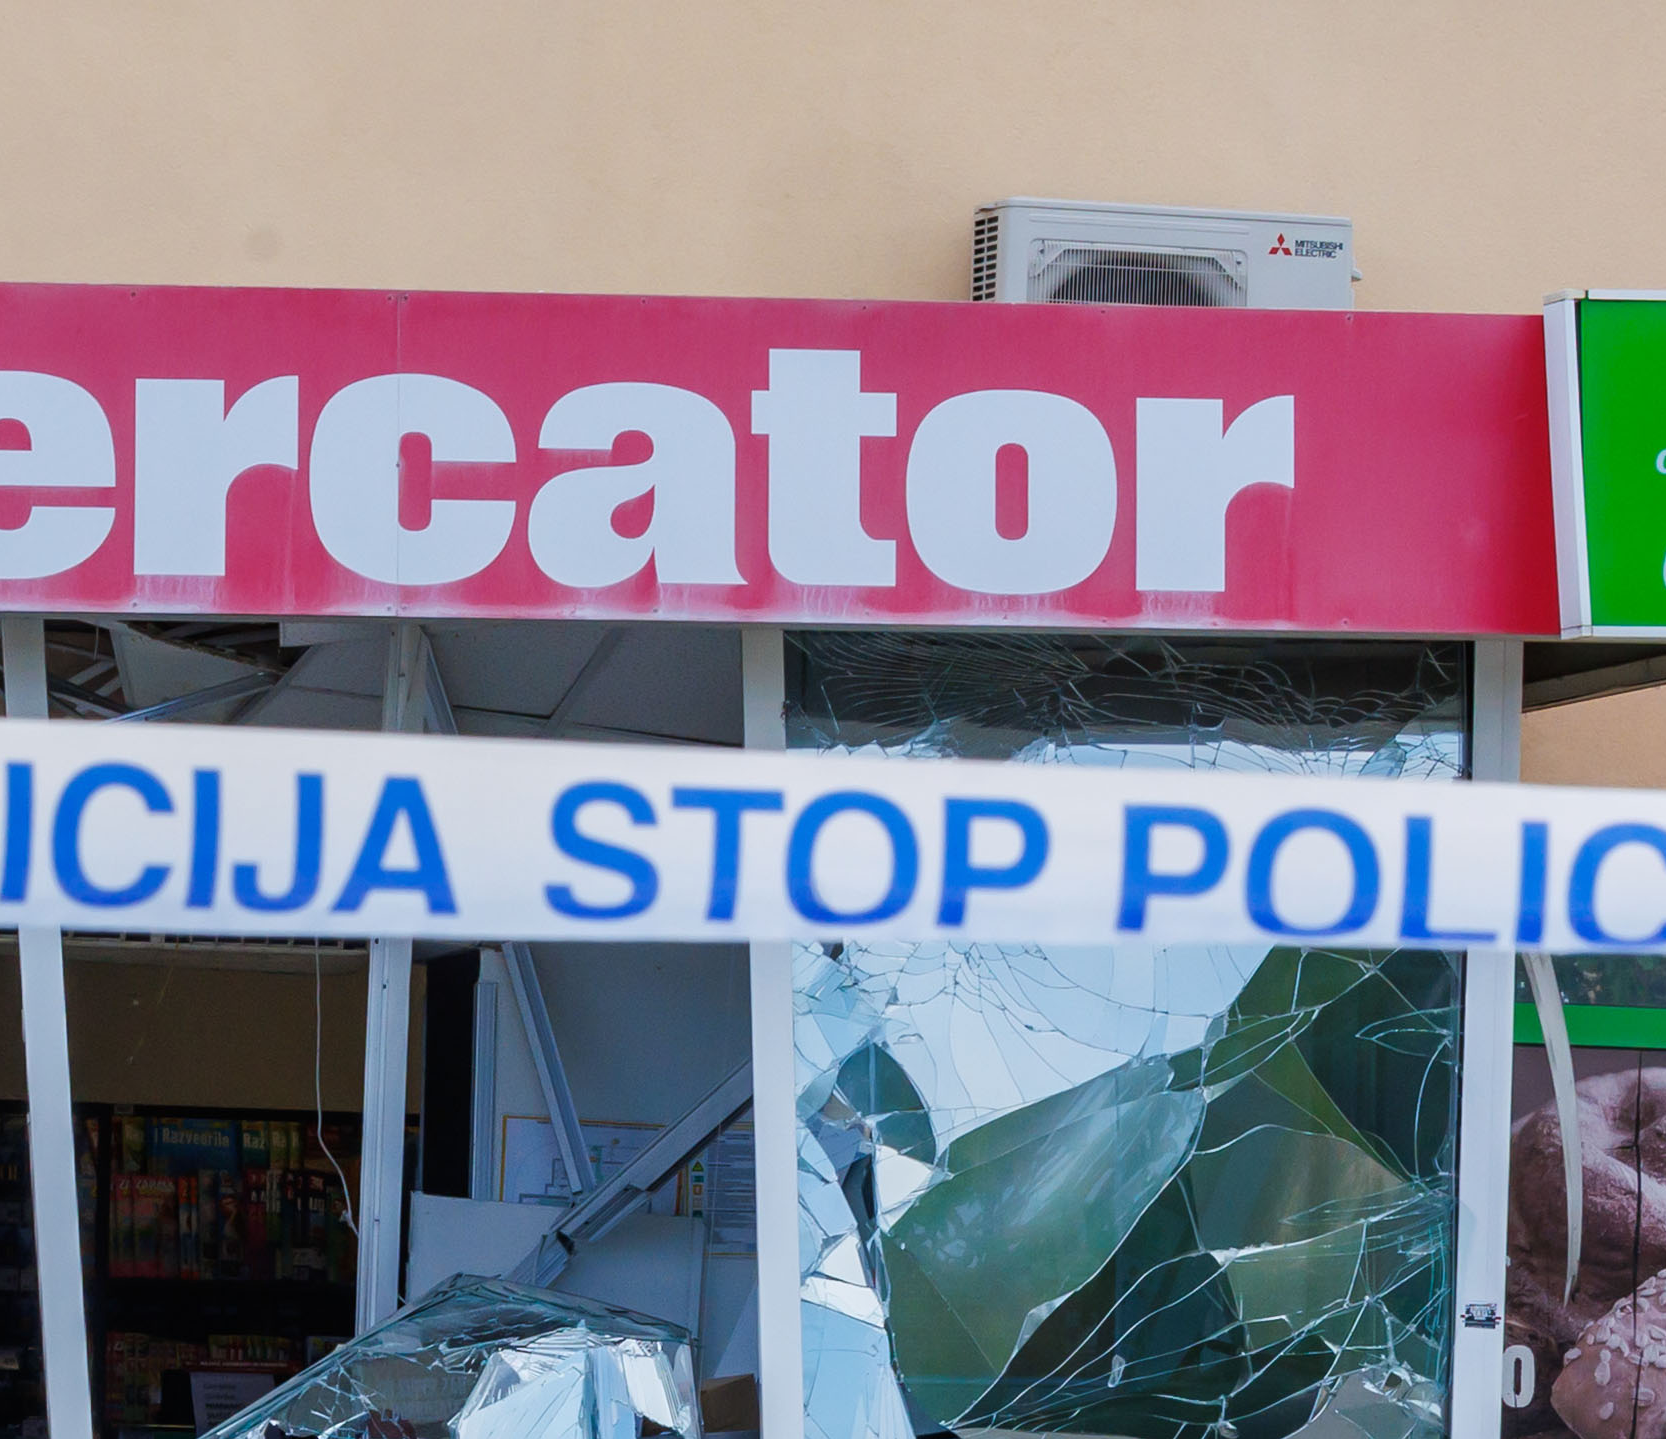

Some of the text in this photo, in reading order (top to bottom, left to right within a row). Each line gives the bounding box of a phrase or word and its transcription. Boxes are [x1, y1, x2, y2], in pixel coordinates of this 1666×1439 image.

[1294, 239, 1344, 251] MITSUBISHI
[1294, 248, 1337, 259] ELECTRIC
[544, 781, 1050, 926] STOP
